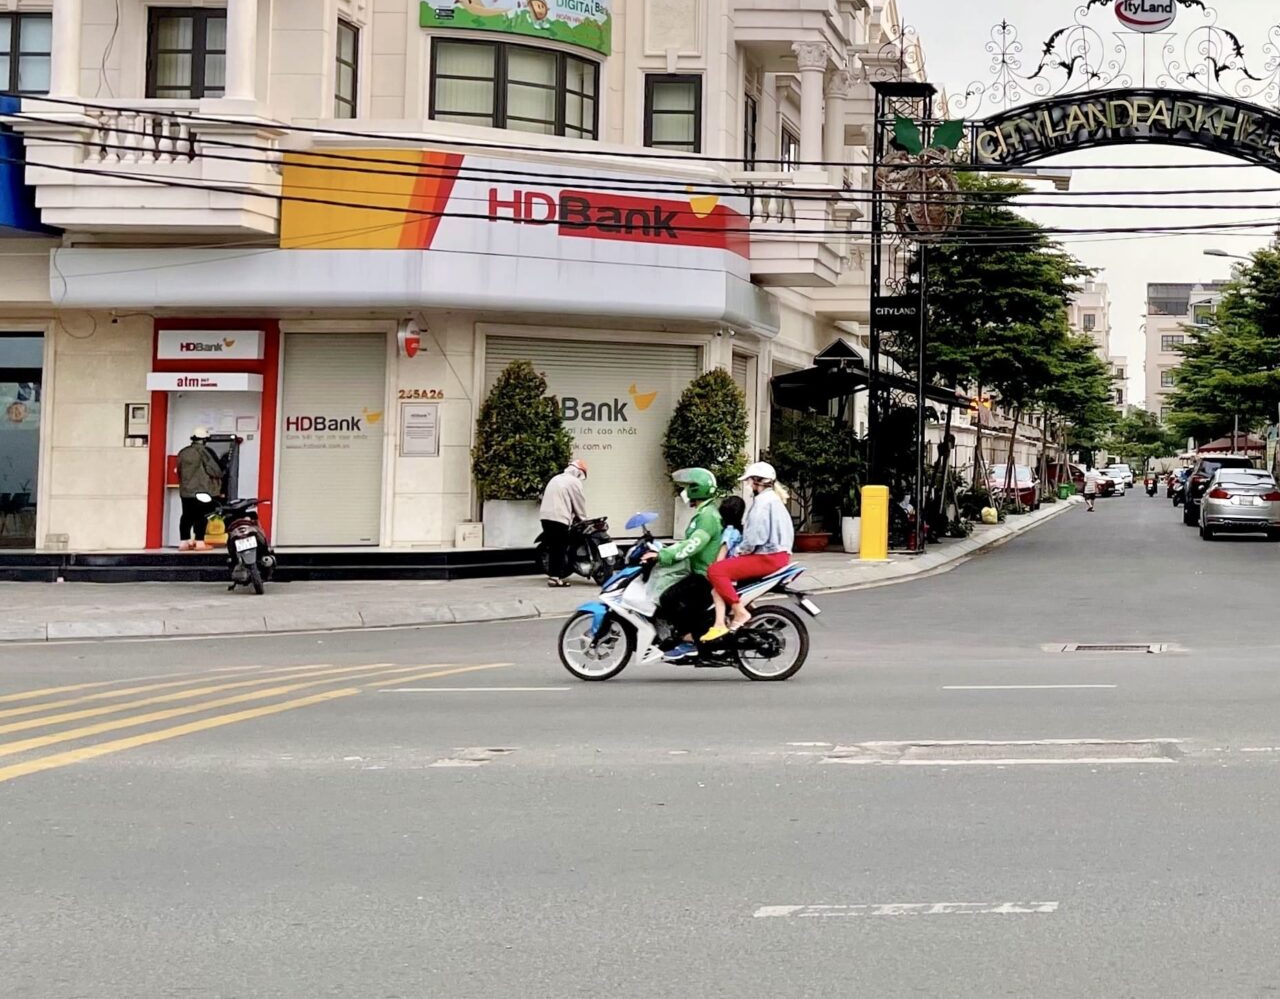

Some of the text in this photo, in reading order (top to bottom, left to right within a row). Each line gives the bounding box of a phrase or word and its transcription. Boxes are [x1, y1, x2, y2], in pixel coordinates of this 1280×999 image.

[488, 188, 678, 239] HDBank
[875, 307, 916, 315] CITYLAND
[180, 342, 223, 352] HDBank
[177, 376, 199, 388] atm
[560, 396, 629, 422] Bank
[286, 416, 362, 432] HDBank
